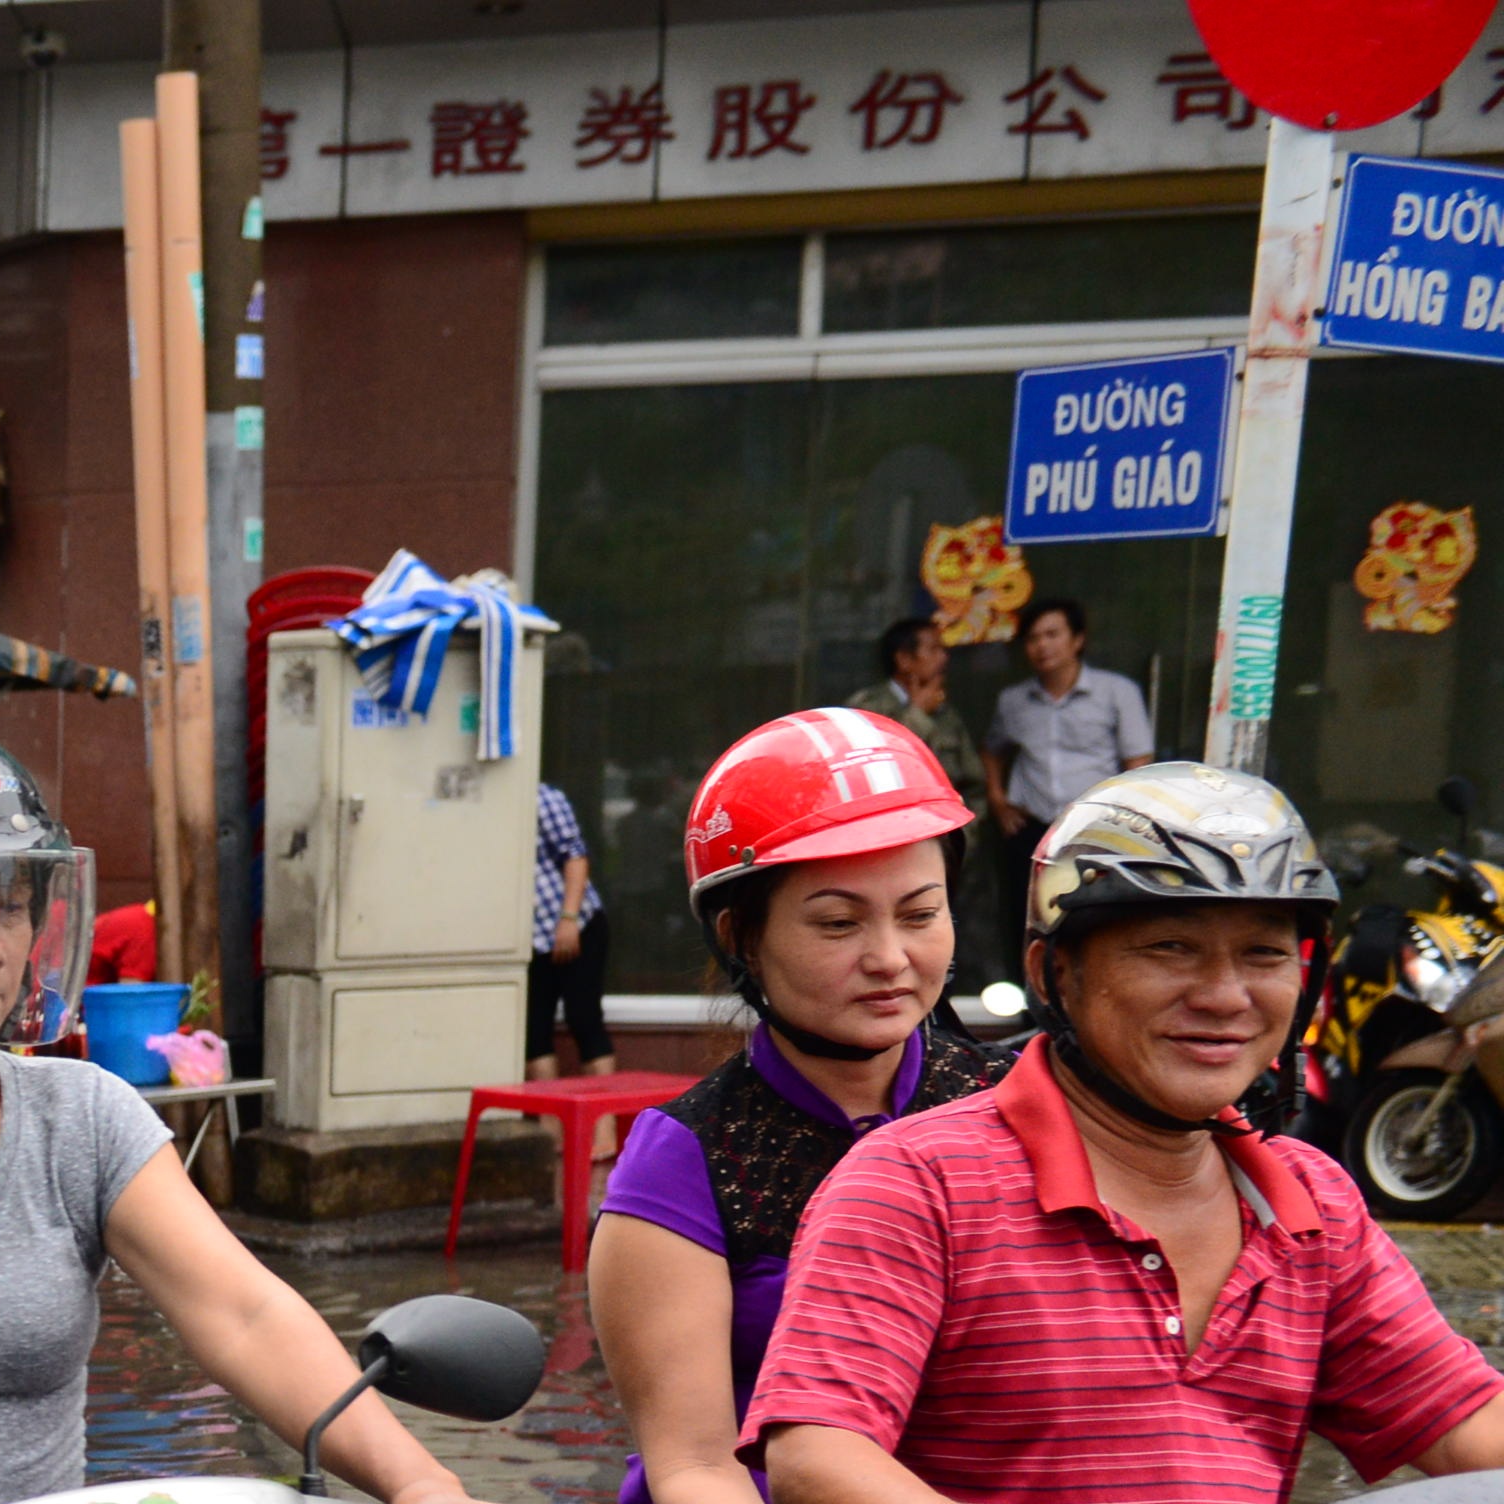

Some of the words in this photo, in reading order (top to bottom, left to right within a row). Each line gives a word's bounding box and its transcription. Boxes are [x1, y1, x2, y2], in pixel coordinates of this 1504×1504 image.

[1334, 245, 1450, 326] HỒNG
[1053, 376, 1186, 437] ĐƯỜNG
[1023, 443, 1097, 516] PHÚ
[1111, 439, 1203, 508] GIÁO
